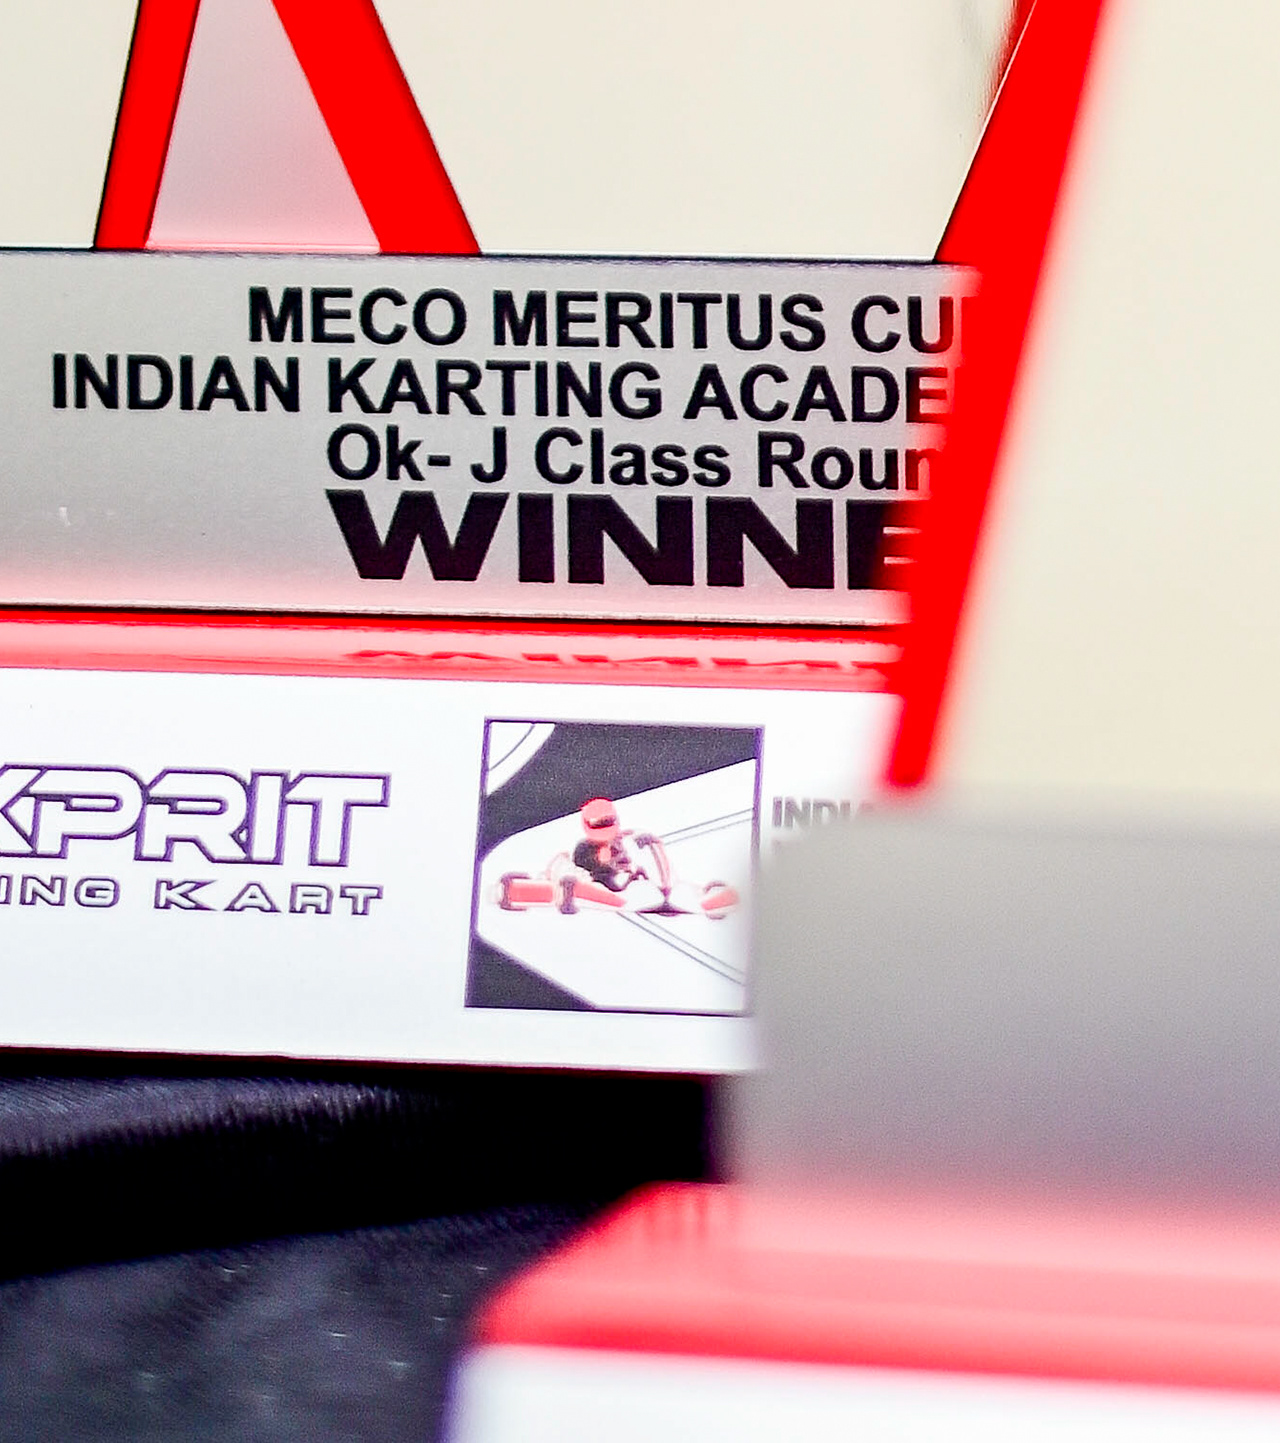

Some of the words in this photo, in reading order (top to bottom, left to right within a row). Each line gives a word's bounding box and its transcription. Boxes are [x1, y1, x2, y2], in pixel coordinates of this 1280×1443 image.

[248, 286, 467, 347] MECO
[492, 289, 827, 353] MERITUS
[850, 293, 960, 354] CU
[52, 353, 301, 413] INDIAN
[326, 357, 663, 421] KARTING
[682, 363, 952, 424] ACADE
[326, 422, 451, 482] Ok-
[470, 426, 509, 485] J
[534, 426, 732, 488] Class
[153, 878, 384, 916] KART
